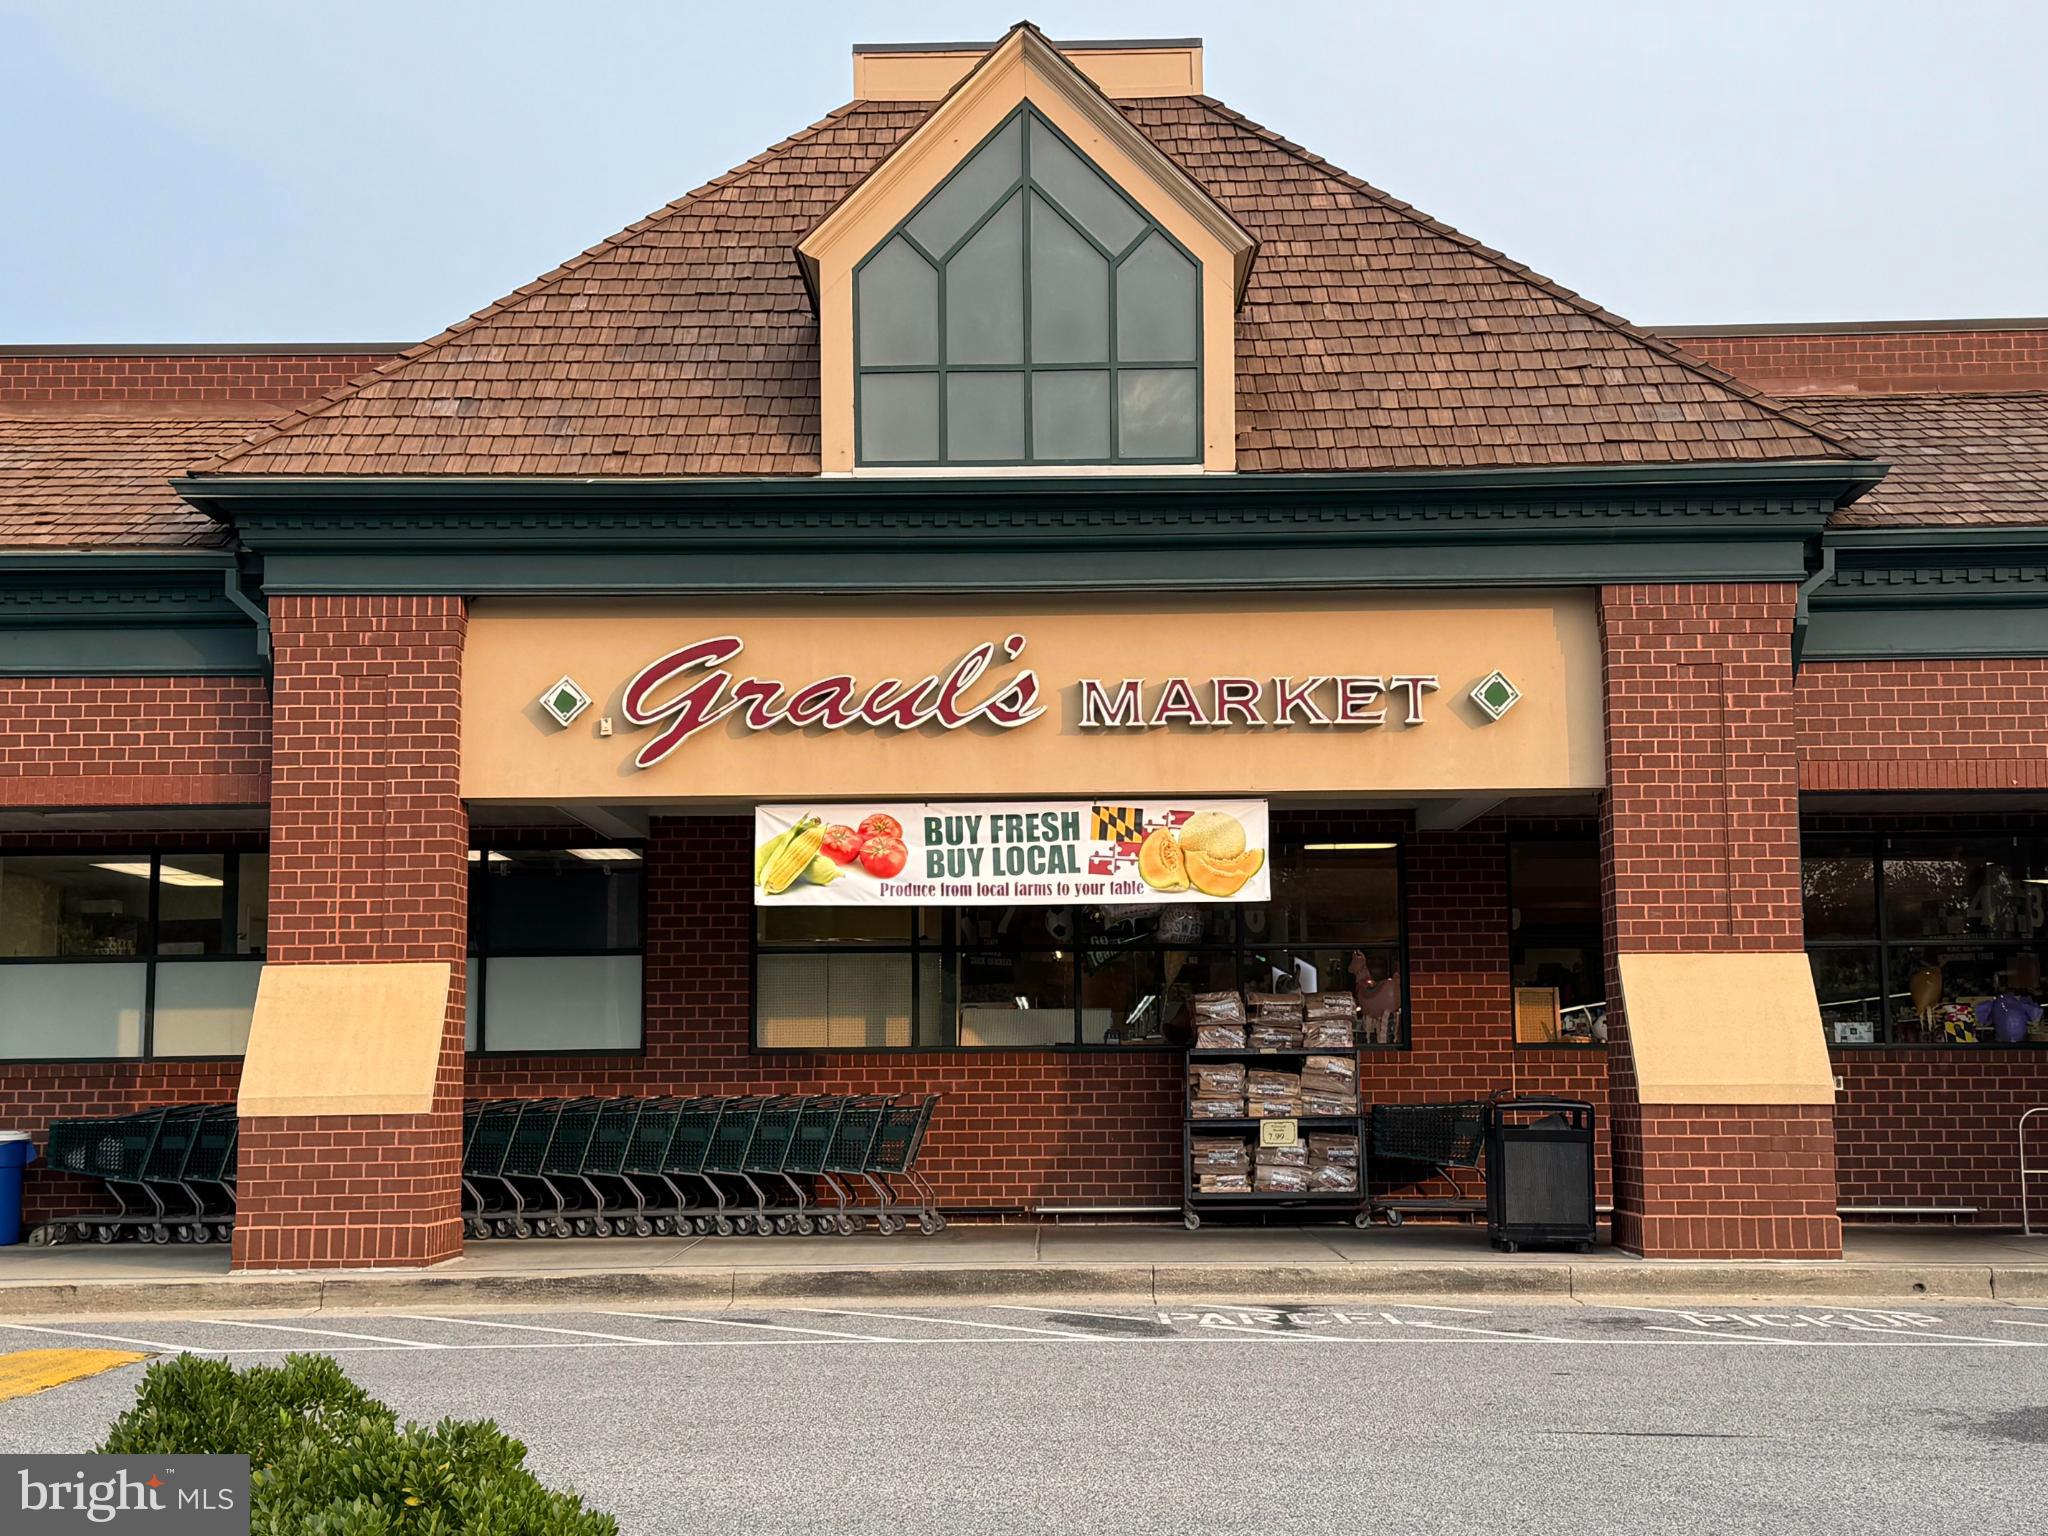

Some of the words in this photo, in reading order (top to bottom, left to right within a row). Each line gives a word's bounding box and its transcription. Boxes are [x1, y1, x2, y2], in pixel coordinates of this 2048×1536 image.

[622, 634, 1048, 767] Graul's
[1077, 674, 1441, 728] MARKET
[923, 815, 982, 846] BUY
[990, 811, 1080, 844] FRESH
[926, 847, 984, 879] BUY
[992, 844, 1081, 876] LOCAL
[879, 882, 936, 897] Produce
[940, 882, 972, 897] from
[977, 882, 1009, 897] local
[1014, 882, 1052, 897] farms
[1057, 882, 1069, 896] to
[1074, 883, 1106, 898] your
[1110, 880, 1144, 896] table
[1155, 1311, 1433, 1326] PARCEL
[1678, 1312, 1944, 1328] PICKUP
